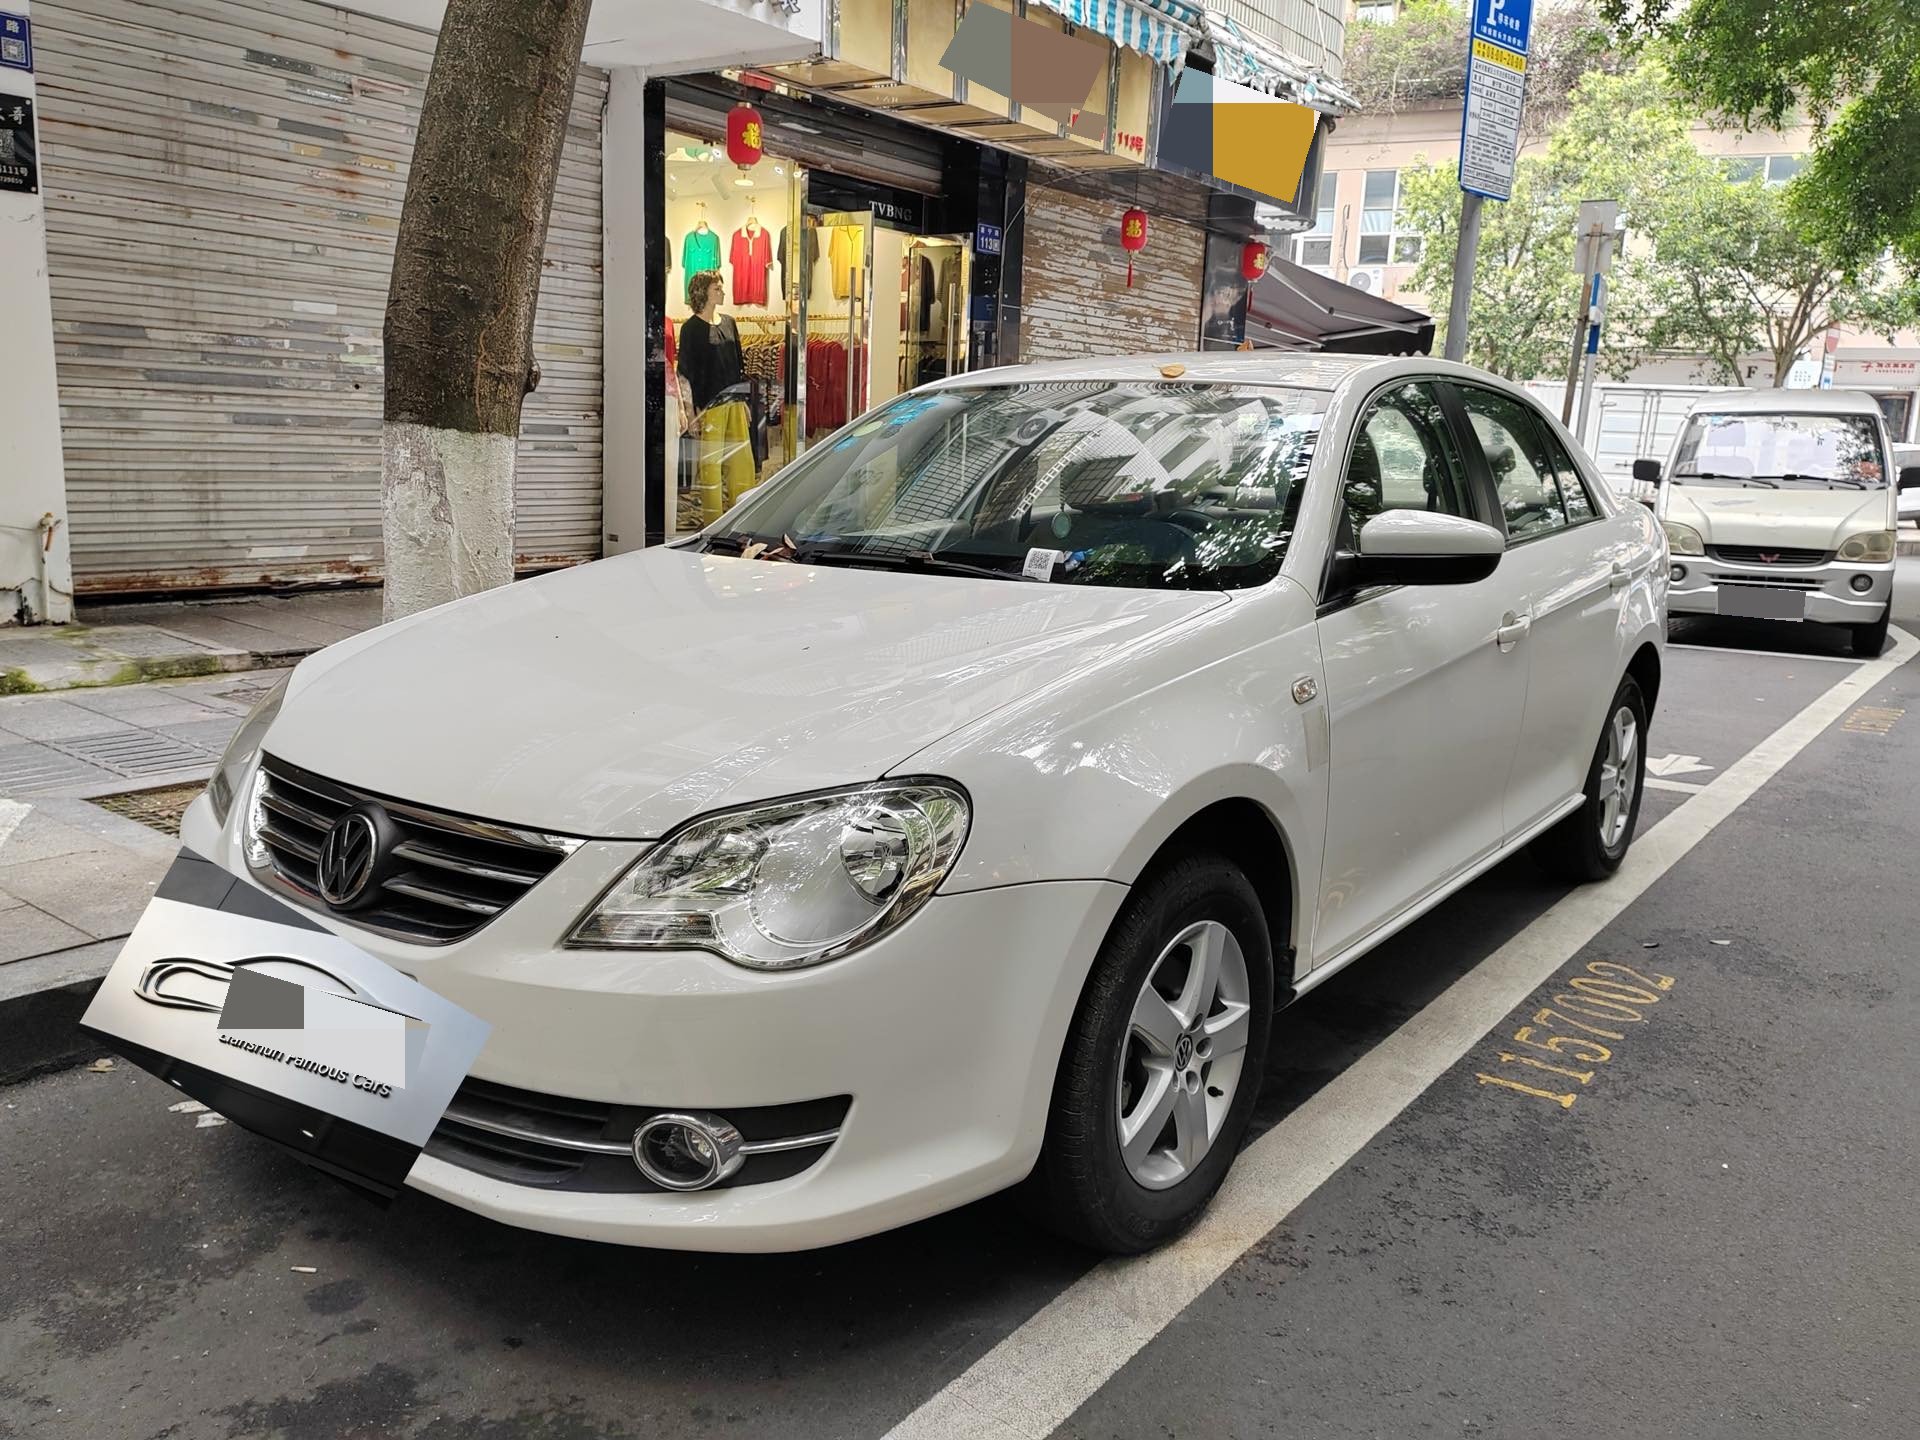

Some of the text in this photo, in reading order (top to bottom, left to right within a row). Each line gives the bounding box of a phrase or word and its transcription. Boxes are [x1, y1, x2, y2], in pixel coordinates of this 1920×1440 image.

[6, 19, 20, 33] 路
[868, 200, 912, 221] TVBNG
[1475, 961, 1677, 1109] 1157002
[286, 1055, 348, 1083] Famous
[352, 1072, 391, 1098] Cars
